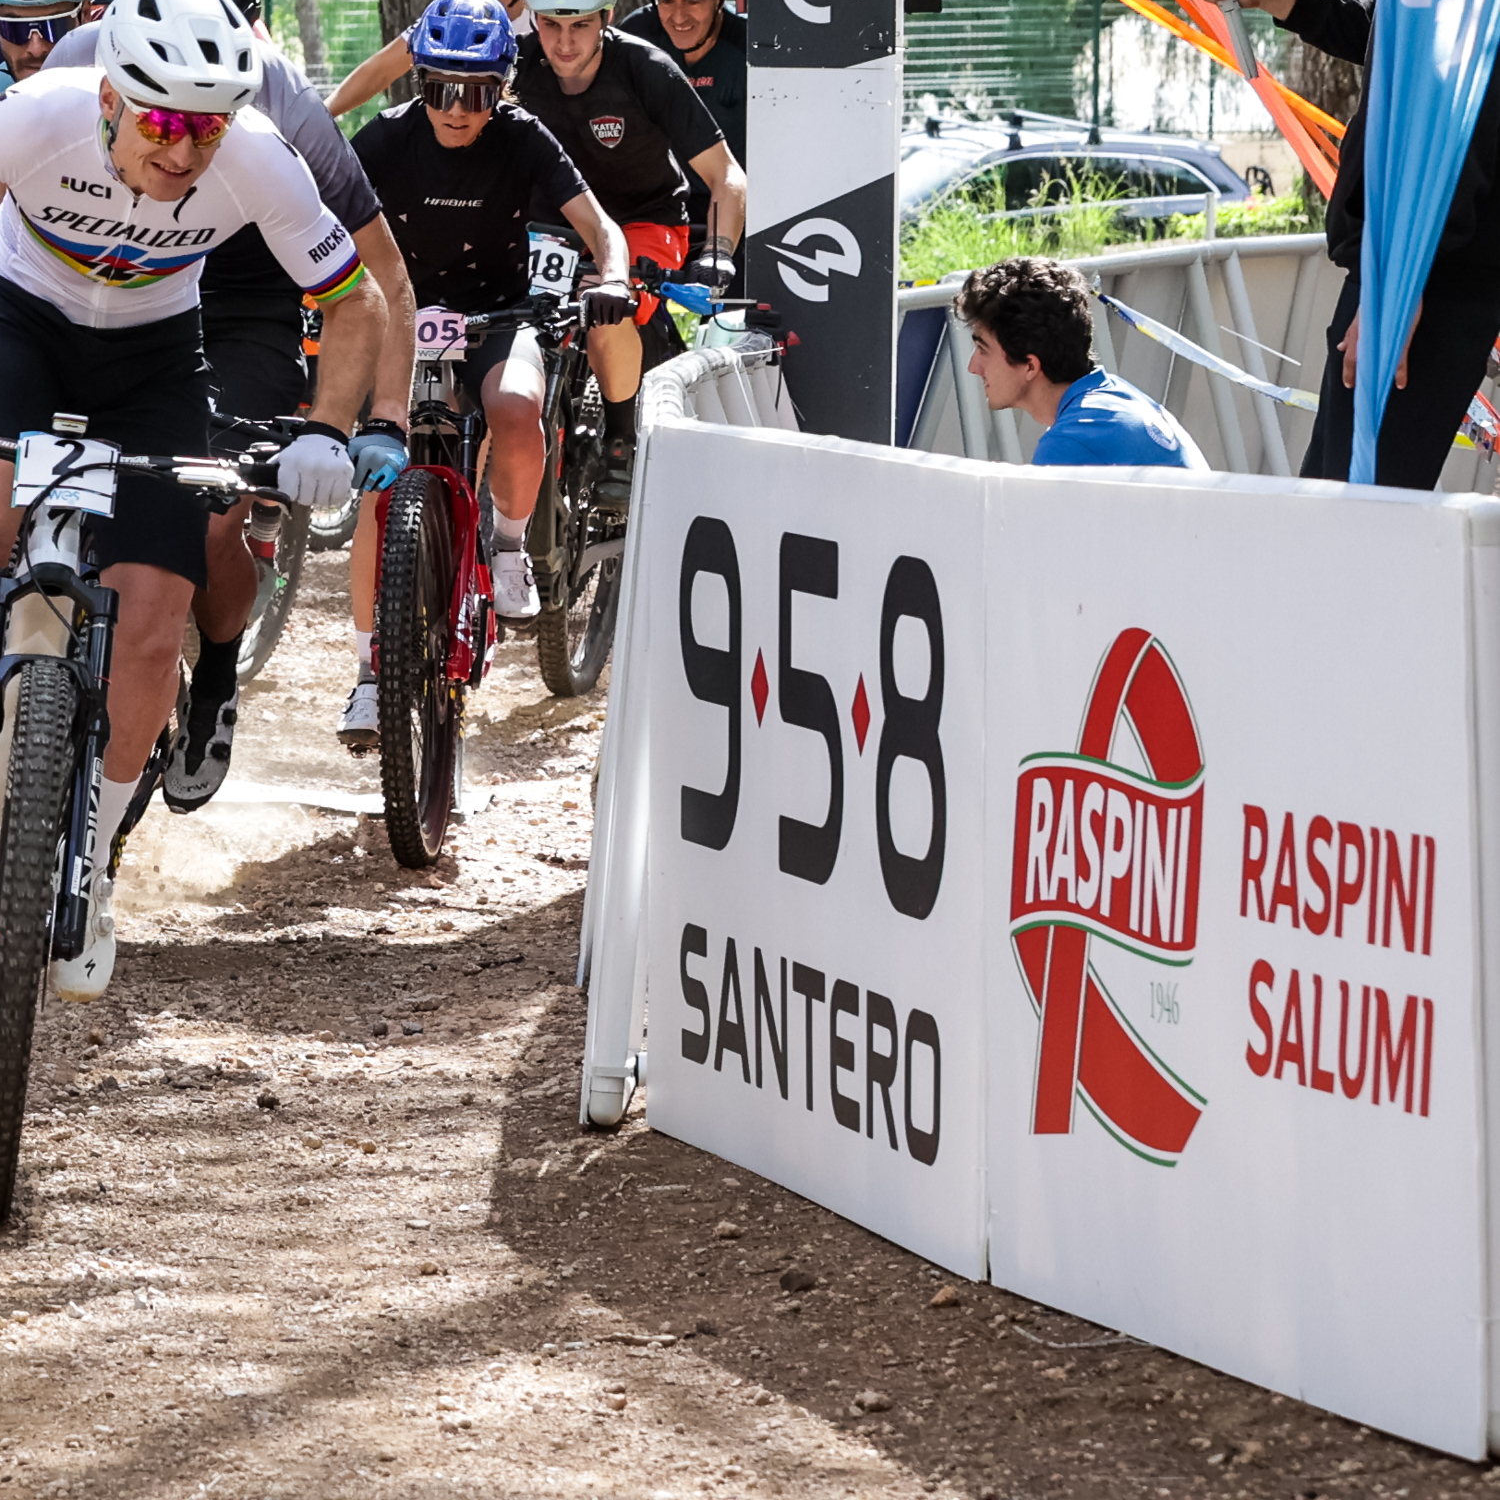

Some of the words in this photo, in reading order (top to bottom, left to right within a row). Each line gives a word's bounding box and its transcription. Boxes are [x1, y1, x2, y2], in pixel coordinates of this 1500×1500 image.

[593, 122, 622, 132] KATEA
[598, 130, 620, 139] BIKE
[69, 178, 112, 200] UCI
[31, 205, 217, 249] SPECIALIZED
[307, 223, 346, 265] ROCKS
[52, 439, 86, 479] 2
[1025, 775, 1194, 958] RASPINI
[1240, 802, 1436, 958] RASPINI
[1147, 979, 1181, 1028] 1946
[679, 921, 942, 1167] SANTERO
[1243, 957, 1436, 1118] SALUMI
